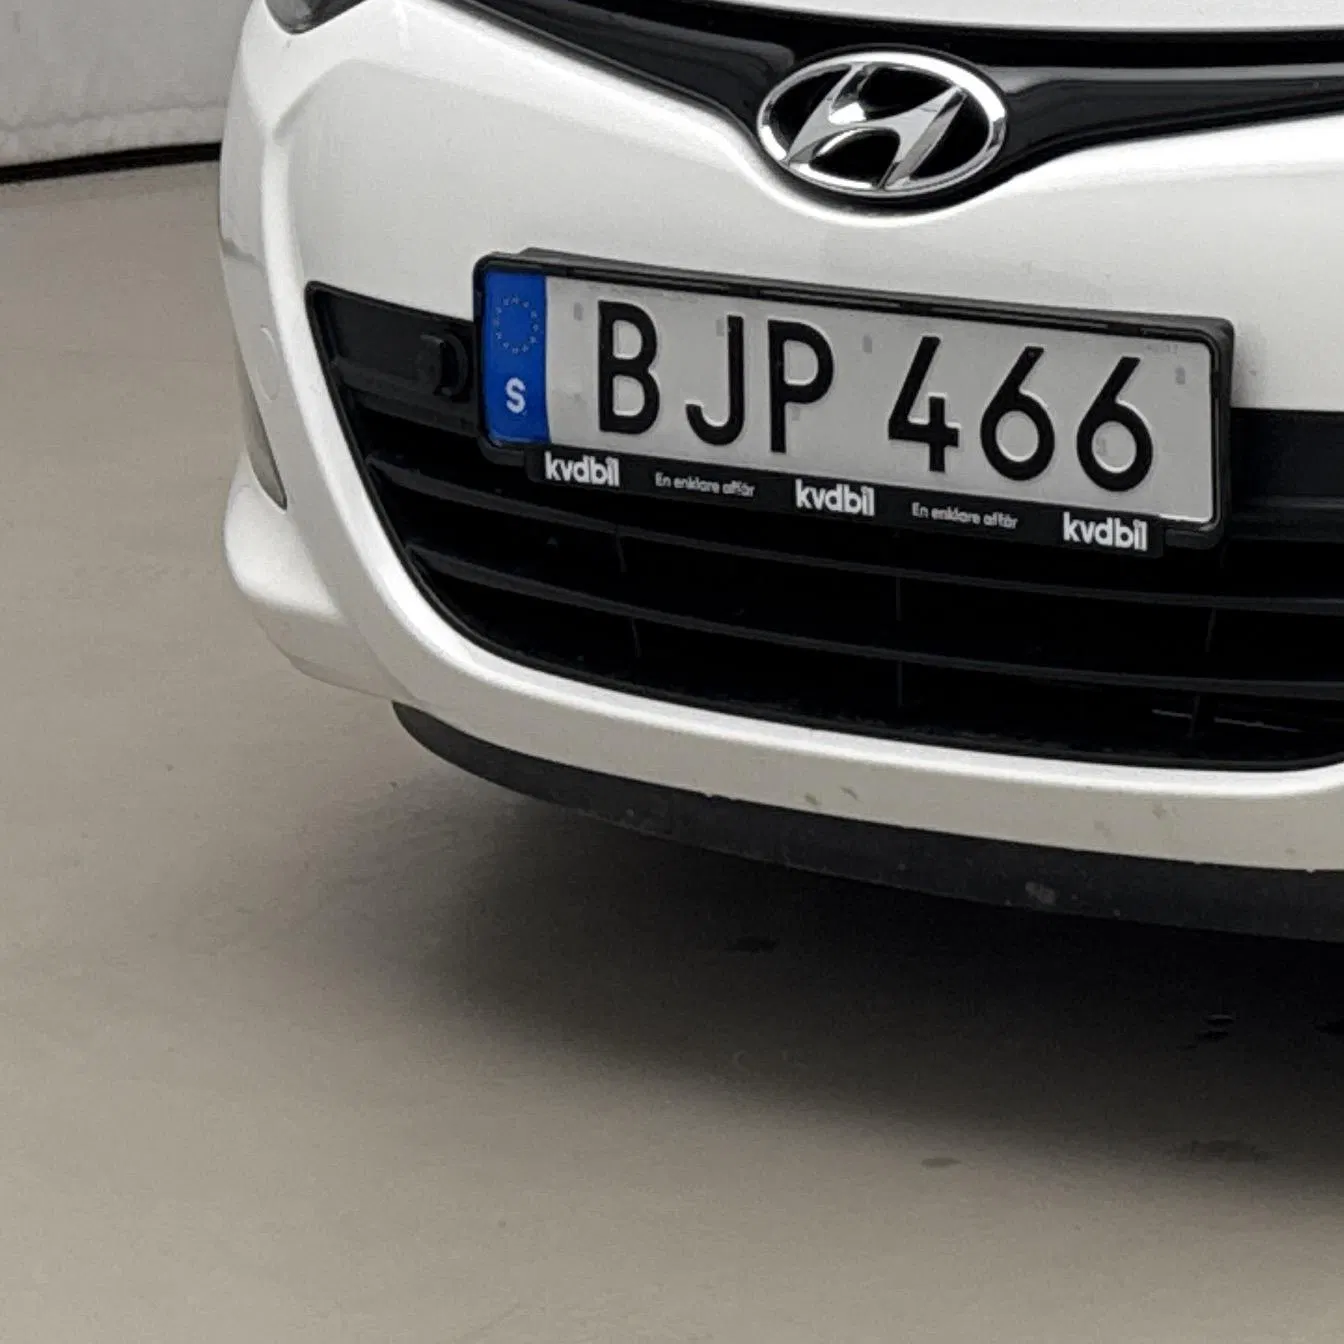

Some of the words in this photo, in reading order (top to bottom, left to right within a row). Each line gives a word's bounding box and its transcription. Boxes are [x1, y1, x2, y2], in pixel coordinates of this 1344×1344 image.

[505, 377, 527, 414] S
[598, 299, 835, 454] BJP
[888, 335, 1154, 492] 466
[544, 451, 620, 487] kvdbil
[655, 472, 671, 487] En
[673, 476, 720, 494] enklare
[795, 478, 875, 516] kvdbil
[912, 502, 929, 518] En
[931, 506, 981, 525] enklare
[1063, 511, 1147, 551] kvdbil
